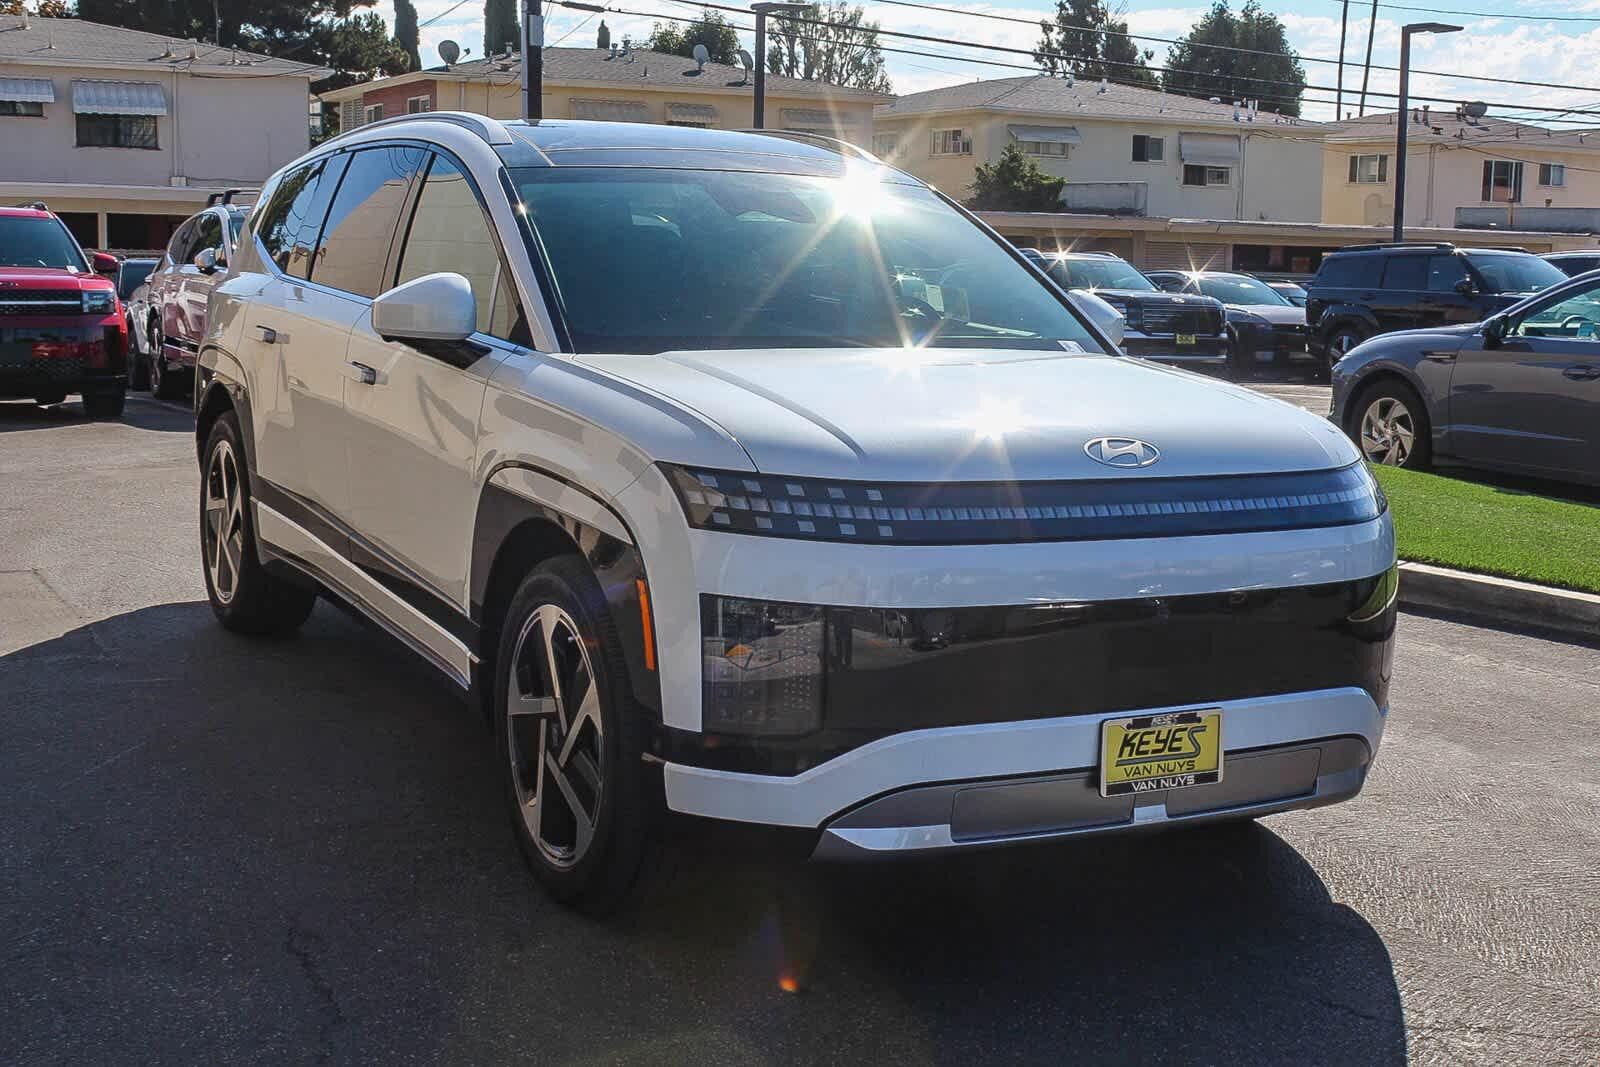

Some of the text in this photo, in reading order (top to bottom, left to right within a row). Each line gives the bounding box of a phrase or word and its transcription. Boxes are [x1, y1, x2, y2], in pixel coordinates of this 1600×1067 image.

[1116, 725, 1207, 765] KEYES
[1124, 760, 1195, 778] VAN NUYS
[1131, 775, 1195, 792] VAN NUYS
